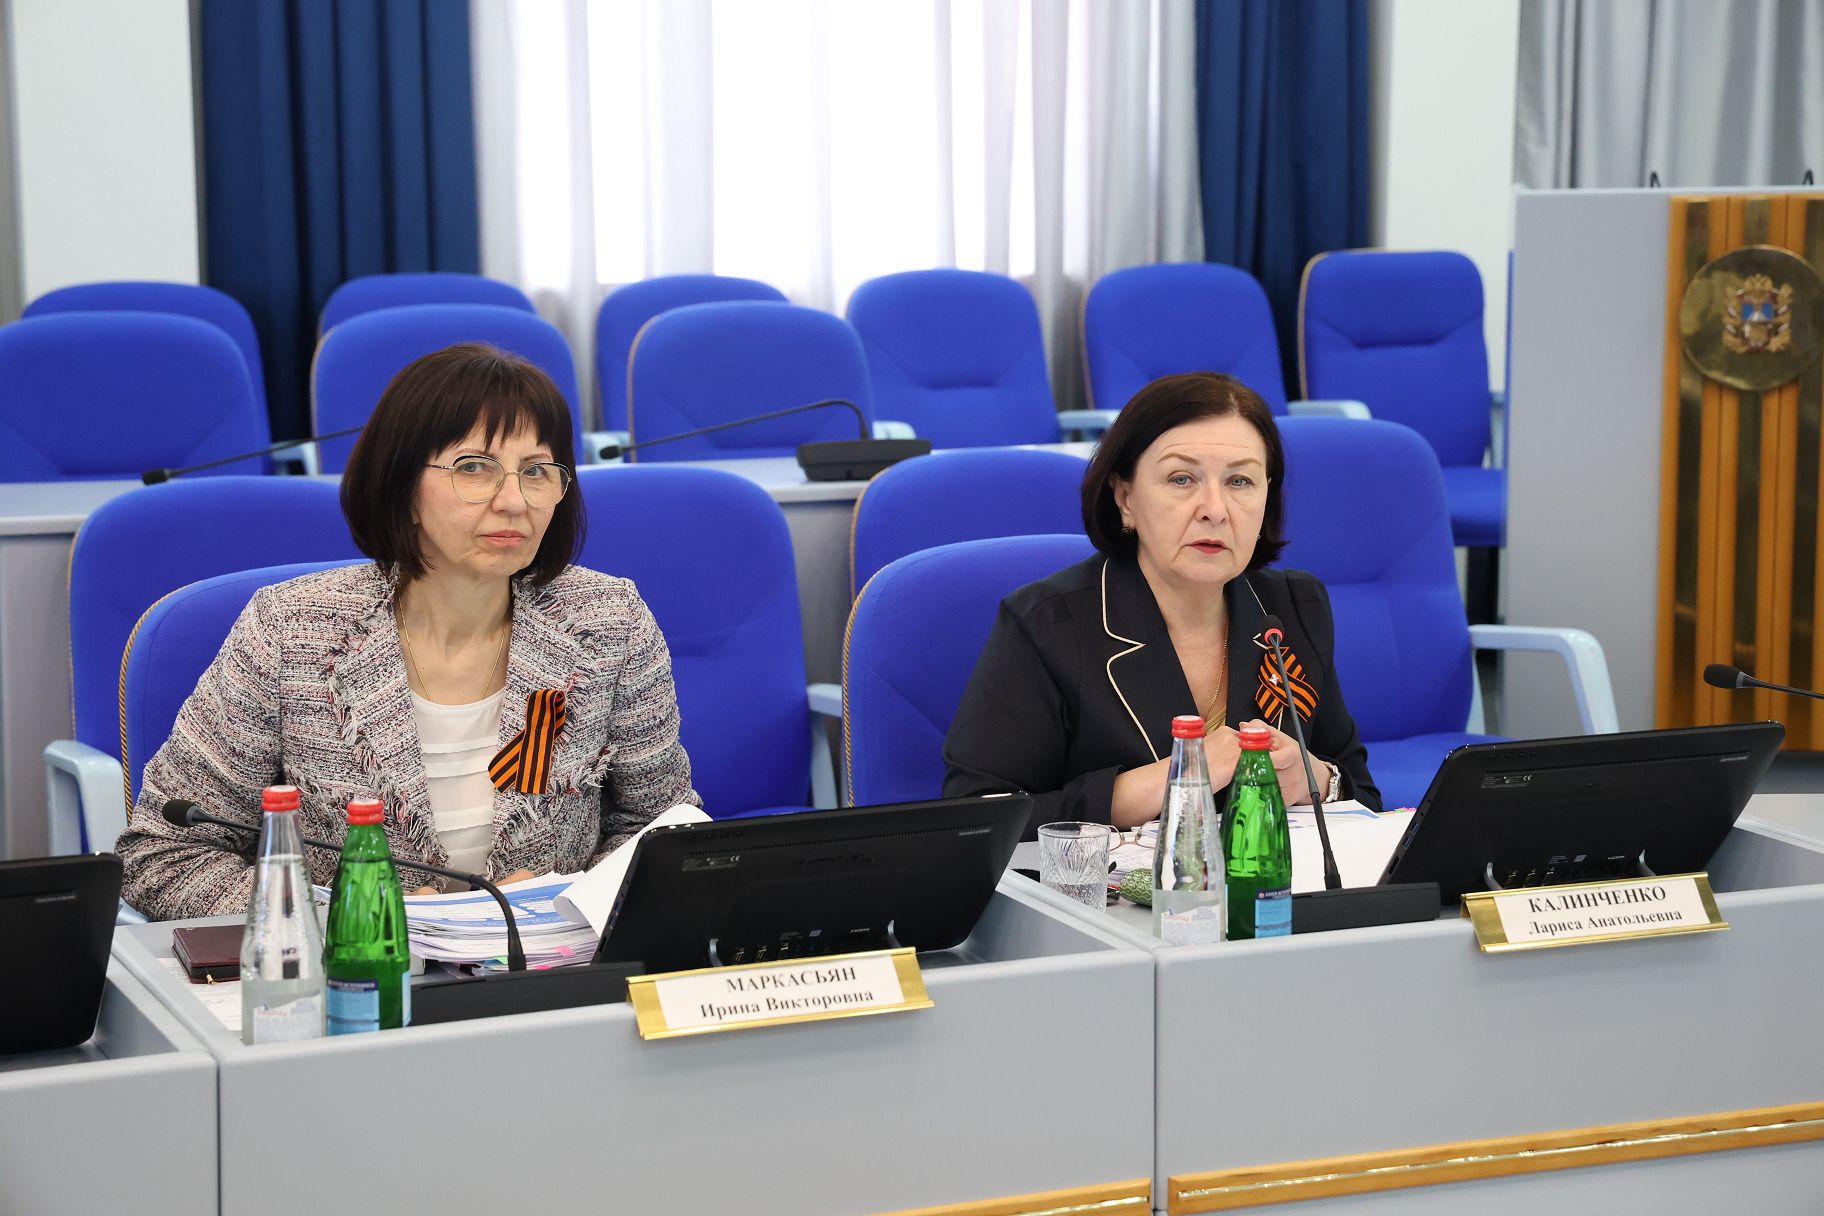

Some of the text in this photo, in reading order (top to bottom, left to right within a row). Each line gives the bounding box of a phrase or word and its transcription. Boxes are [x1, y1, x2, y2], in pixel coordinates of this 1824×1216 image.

[1528, 886, 1666, 913] КАЛИНЧЕНКО
[1529, 910, 1683, 936] Лариса Анатольевна
[726, 966, 857, 993] МАРКАСЬЯН
[700, 990, 874, 1020] Ирина Викторовна
